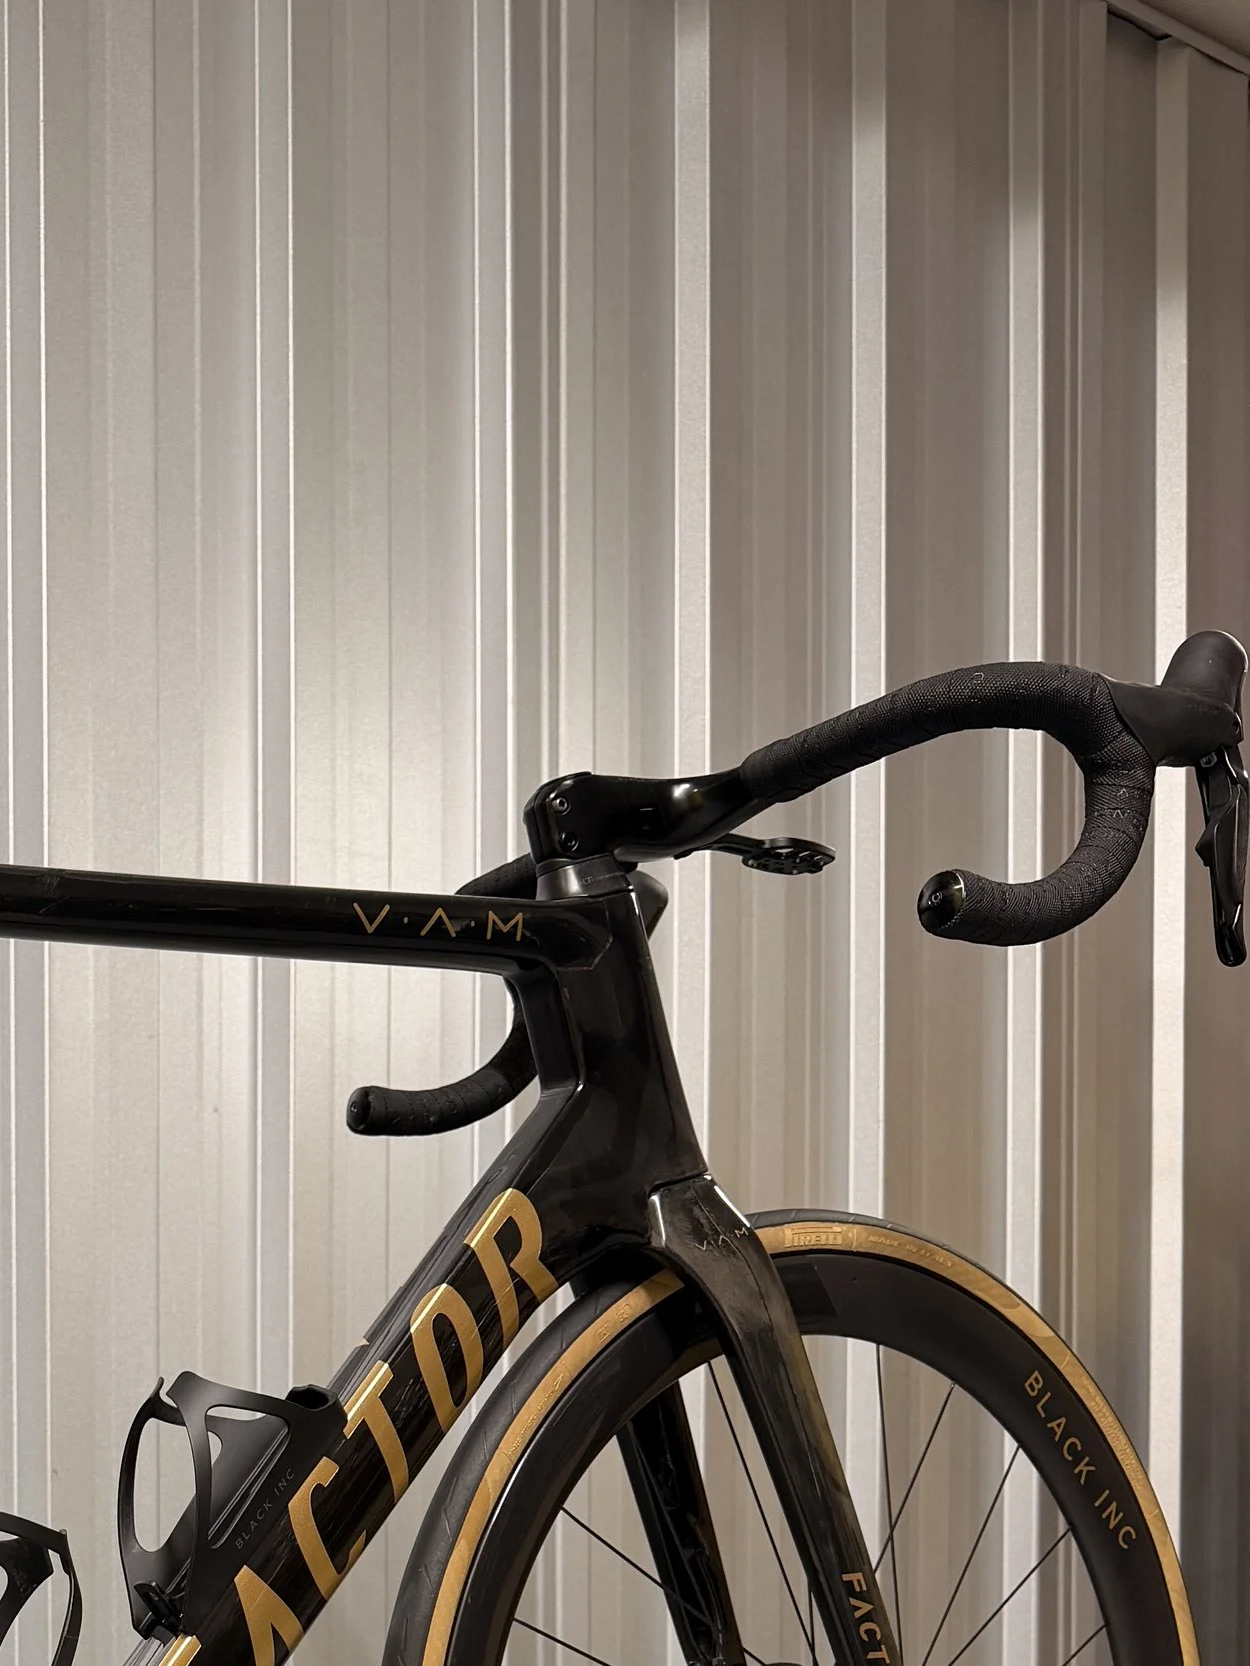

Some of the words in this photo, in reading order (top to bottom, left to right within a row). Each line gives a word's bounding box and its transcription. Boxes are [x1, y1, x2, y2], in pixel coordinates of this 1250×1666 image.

[784, 1225, 843, 1248] PIRELLI
[1024, 1369, 1096, 1486] BLACK
[1094, 1488, 1137, 1551] INC
[235, 1499, 273, 1550] BLACK
[273, 1468, 295, 1496] INC
